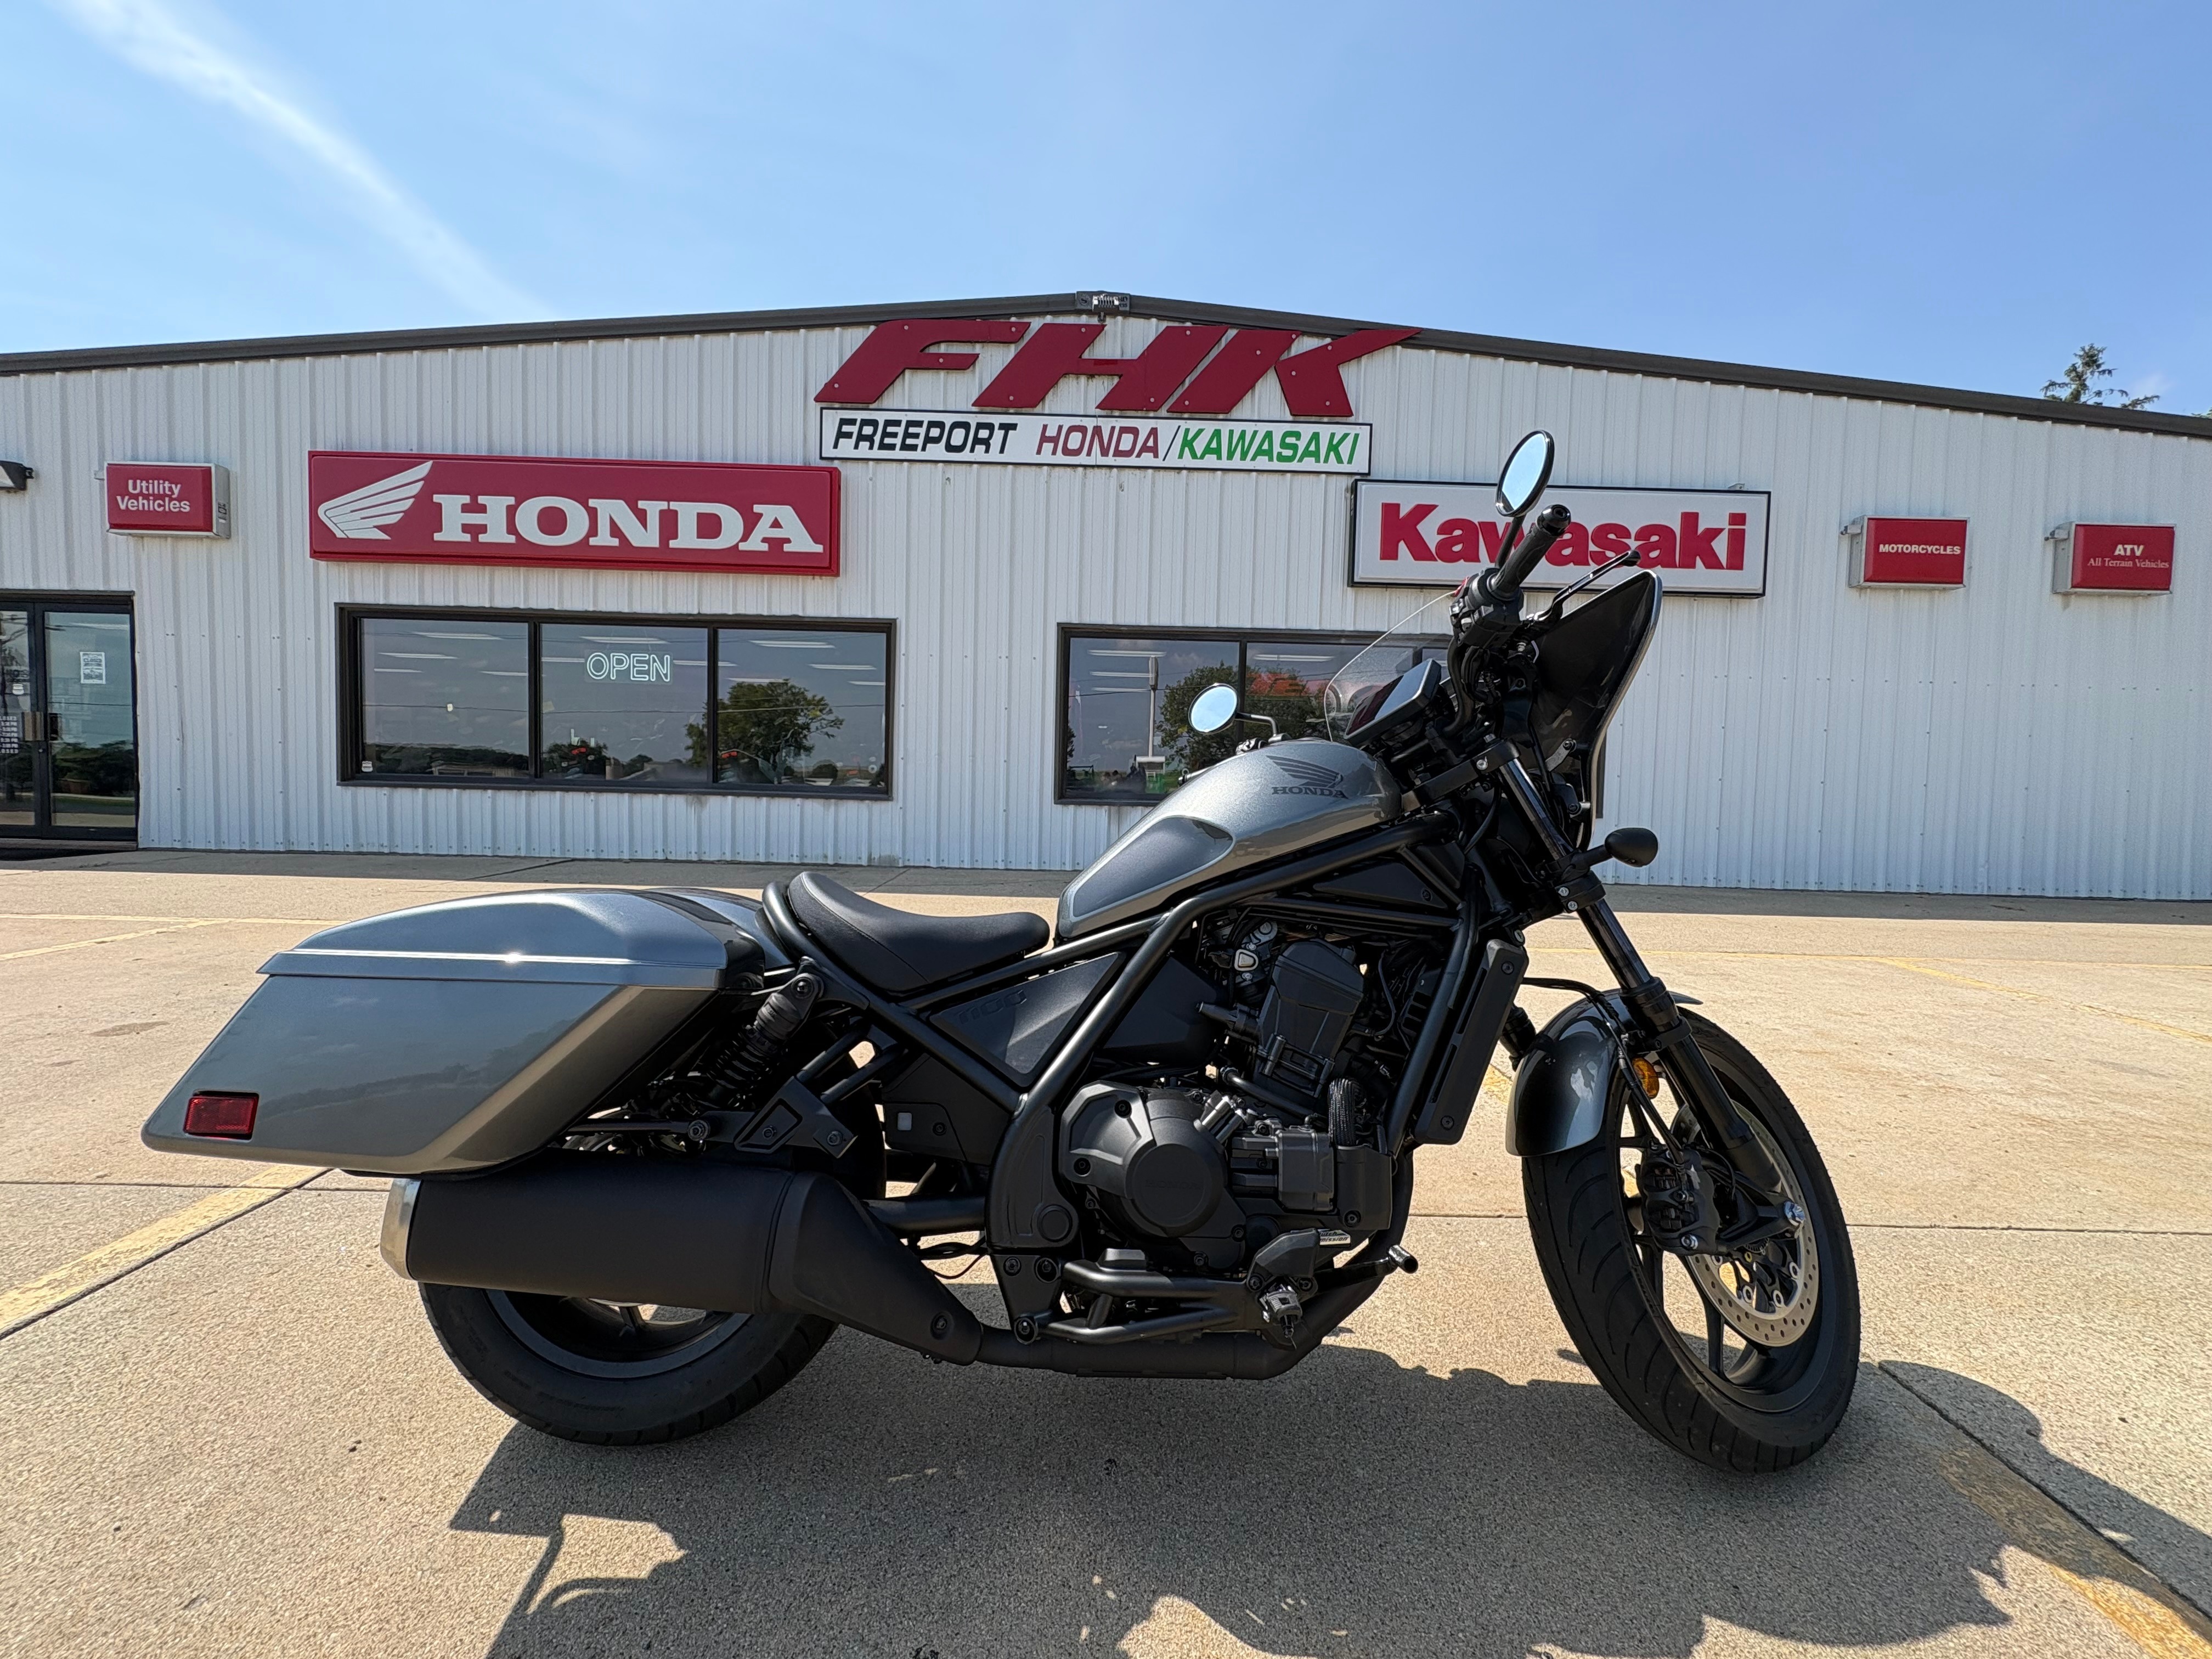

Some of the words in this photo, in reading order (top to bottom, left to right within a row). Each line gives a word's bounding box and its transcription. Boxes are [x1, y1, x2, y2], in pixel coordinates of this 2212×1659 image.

[814, 319, 1421, 417] FHK
[832, 417, 1018, 456] FREEPORT
[128, 479, 182, 498] Utility
[116, 495, 190, 512] Vehicles
[433, 494, 823, 553] HONDA
[1878, 544, 1961, 555] MOTORCYCLES
[2114, 544, 2144, 556] ATV
[2087, 557, 2101, 567] All
[2103, 557, 2133, 567] Terrain
[2135, 558, 2170, 569] Vehicles
[586, 652, 671, 682] OPEN
[1271, 786, 1348, 799] HONDA
